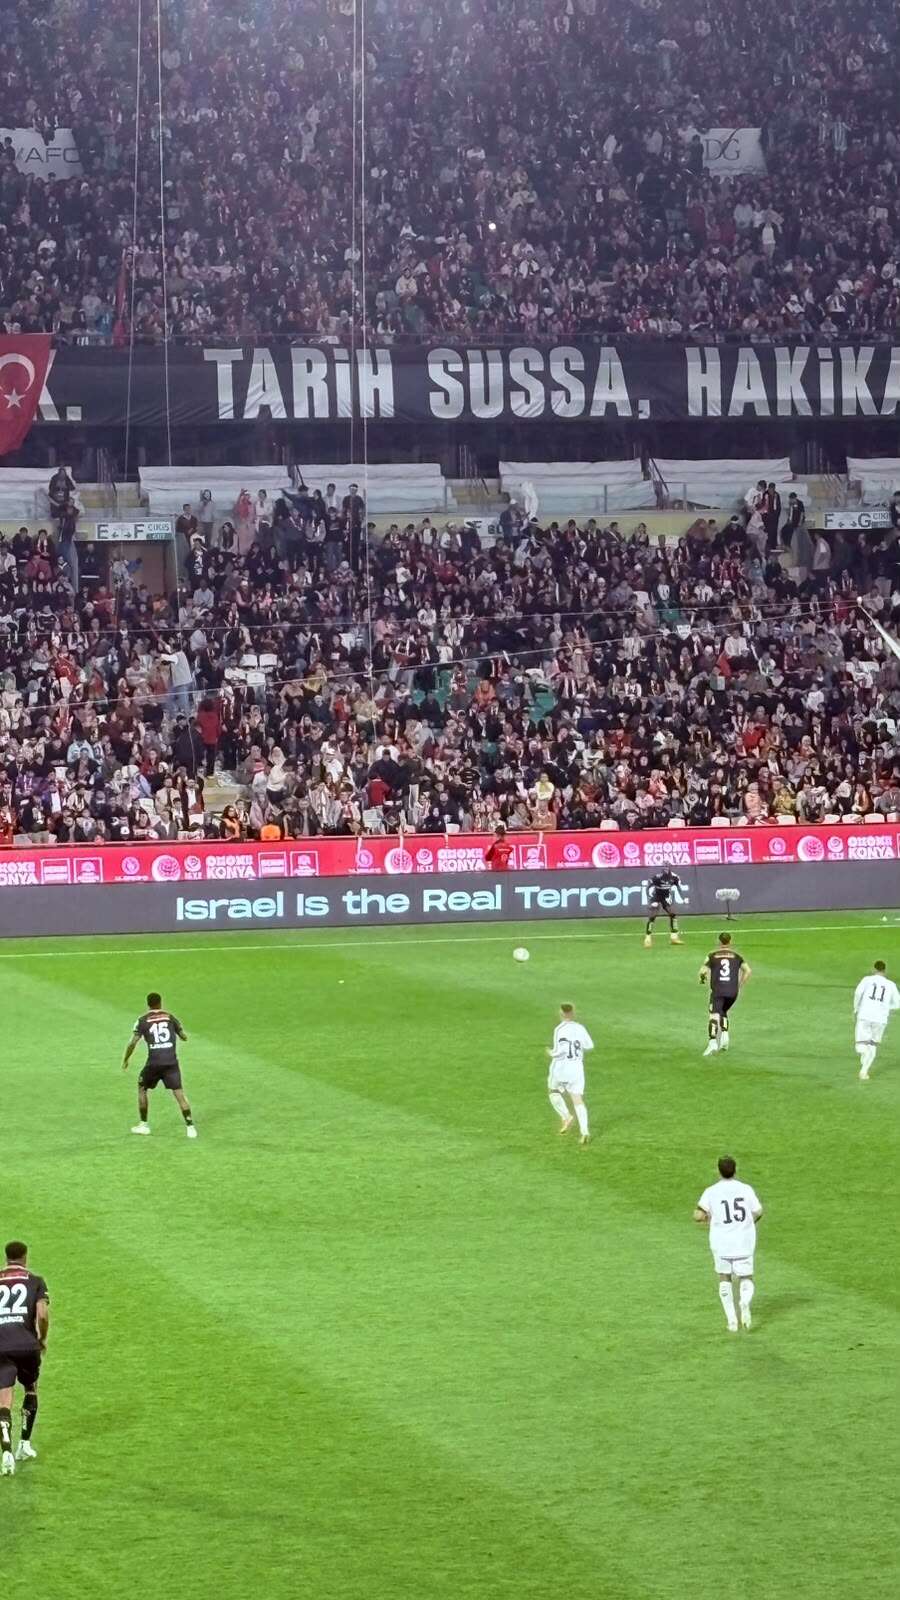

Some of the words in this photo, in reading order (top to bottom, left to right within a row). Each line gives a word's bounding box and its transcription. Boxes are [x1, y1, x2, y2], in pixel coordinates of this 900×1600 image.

[824, 513, 835, 528] F
[858, 513, 871, 528] G
[97, 523, 109, 539] E
[134, 523, 145, 539] F
[644, 853, 692, 866] KONYA
[846, 846, 895, 859] KONYA
[206, 866, 257, 880] KONYA
[437, 858, 487, 872] KONYA
[0, 872, 40, 886] ONYA
[176, 891, 284, 920] Israel
[297, 893, 329, 916] Is
[342, 888, 410, 915] the
[423, 884, 502, 912] Real
[719, 958, 731, 977] 3
[868, 982, 886, 1003] 11
[149, 1021, 171, 1044] 15
[559, 1037, 581, 1059] 18
[720, 1197, 746, 1224] 15
[0, 1283, 28, 1315] 22
